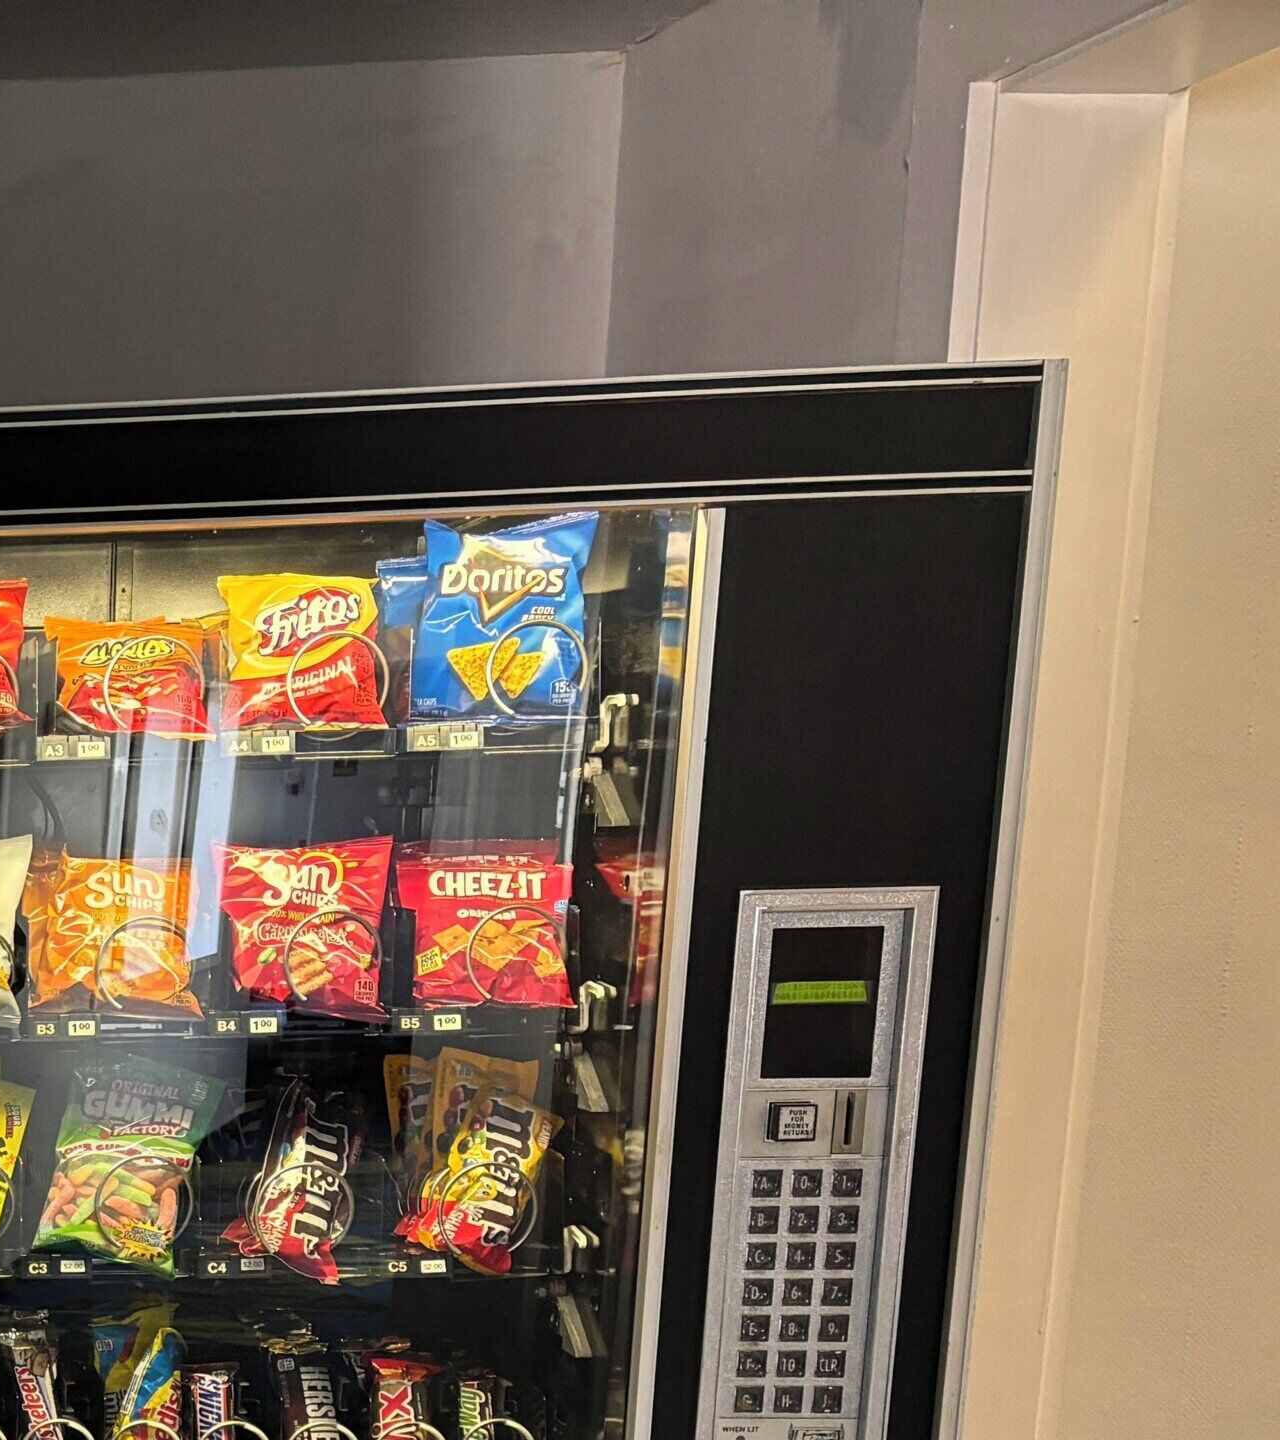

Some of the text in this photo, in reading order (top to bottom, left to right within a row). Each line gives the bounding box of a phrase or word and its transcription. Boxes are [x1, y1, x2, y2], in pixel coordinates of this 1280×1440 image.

[441, 565, 568, 595] Doritos
[531, 606, 554, 615] COOL
[260, 593, 360, 654] Fritos
[291, 656, 357, 690] RIGINAL
[231, 742, 249, 752] A4
[417, 736, 435, 746] A5
[85, 869, 165, 909] Sun
[263, 863, 341, 907] Sun
[429, 870, 547, 900] CHEEZ-IT
[115, 897, 164, 913] CHIPS
[292, 889, 339, 908] CHIPS
[218, 1021, 236, 1032] B4
[401, 1018, 420, 1029] B5
[111, 1079, 179, 1100] ORIGINAL
[83, 1090, 195, 1127] GUMMI
[113, 1125, 179, 1136] FACTORY
[207, 1262, 226, 1273] C4
